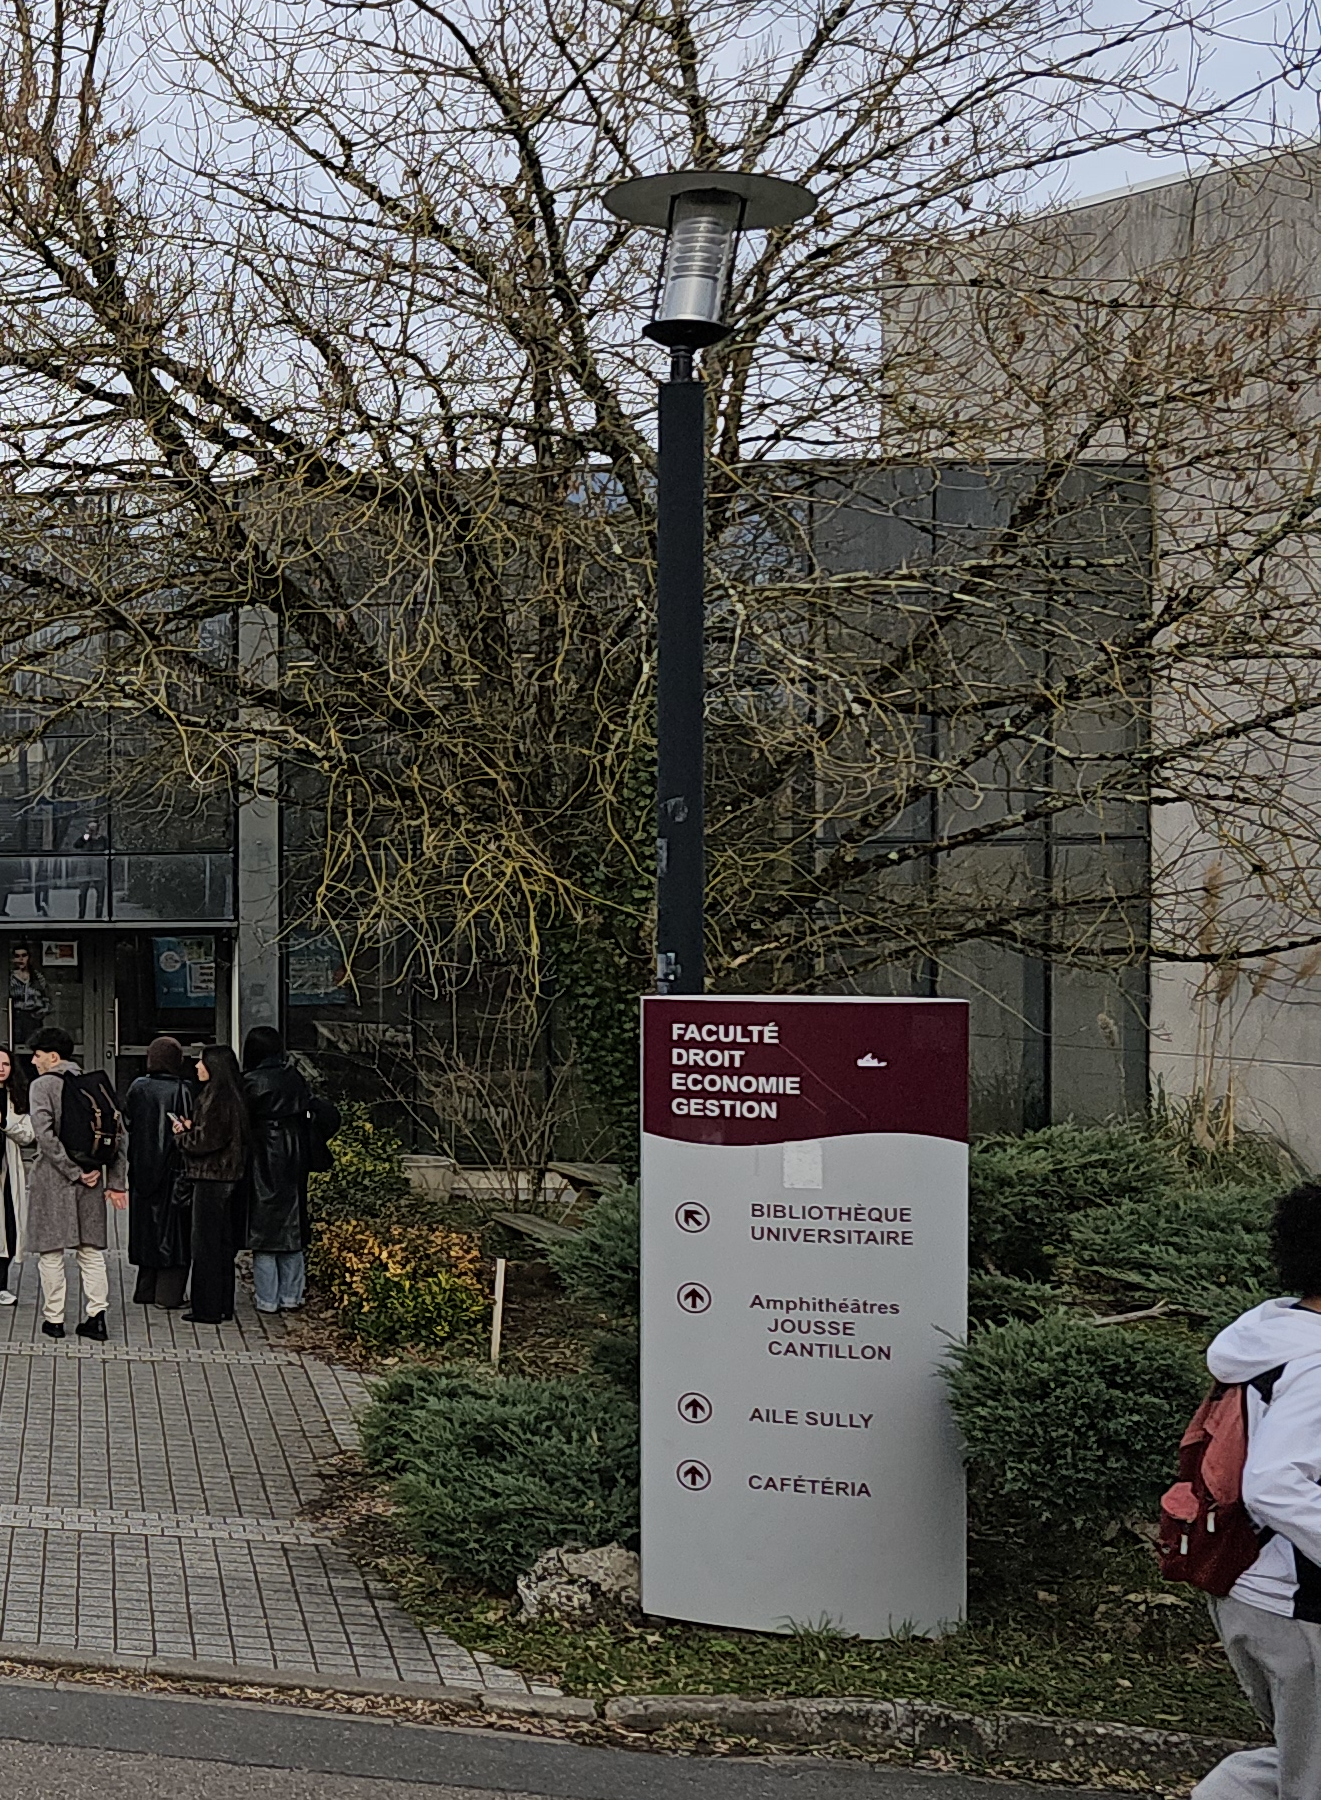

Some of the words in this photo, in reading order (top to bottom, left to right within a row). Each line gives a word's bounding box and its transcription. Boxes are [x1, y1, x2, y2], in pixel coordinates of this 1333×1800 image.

[671, 1021, 780, 1044] FACULTÉ
[671, 1047, 746, 1068] DROIT
[671, 1072, 801, 1095] ECONOMIE
[671, 1097, 778, 1119] GESTION
[750, 1202, 913, 1223] BIBLIOTHÈQUE
[750, 1225, 914, 1246] UNIVERSITAIRE
[749, 1294, 901, 1315] Amphithéâtres
[767, 1317, 856, 1337] JOUSSE
[767, 1340, 892, 1361] CANTILLON
[748, 1407, 799, 1426] AILE
[805, 1411, 874, 1429] SULLY
[748, 1474, 872, 1498] CAFÉTÉRIA
